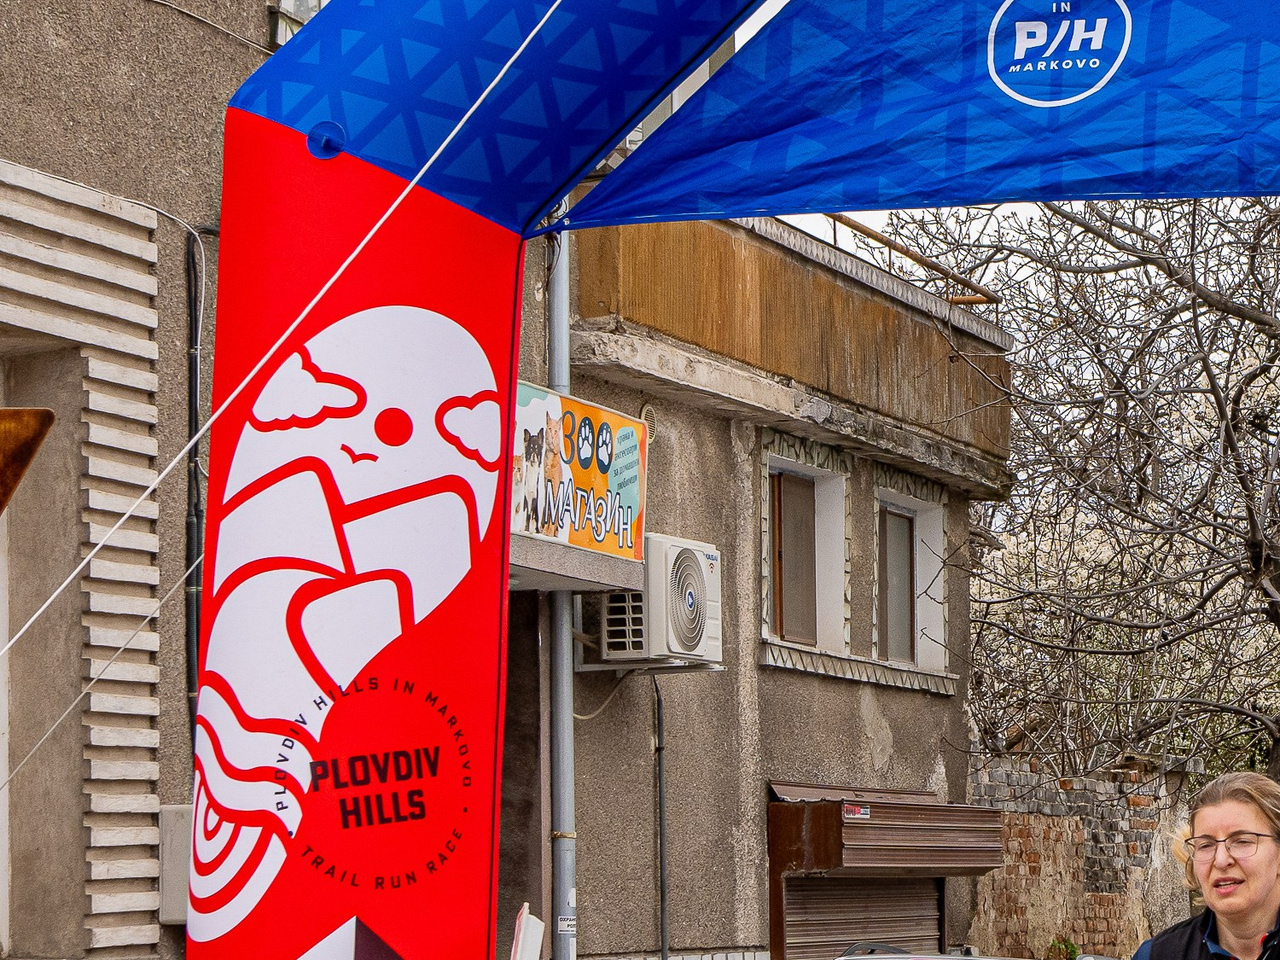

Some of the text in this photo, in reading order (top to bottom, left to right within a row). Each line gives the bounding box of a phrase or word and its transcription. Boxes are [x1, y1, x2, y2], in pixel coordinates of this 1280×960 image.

[1052, 2, 1071, 13] IN
[1014, 18, 1108, 60] P/H
[1008, 58, 1100, 73] MARKOVO
[543, 478, 633, 549] МАГАЗИН
[274, 677, 472, 812] PLOVDIV HILLS IN MARKOVO
[309, 746, 440, 792] PLOVDIV
[338, 789, 426, 829] HILLS
[301, 828, 462, 890] TRAIL RUN RACE
